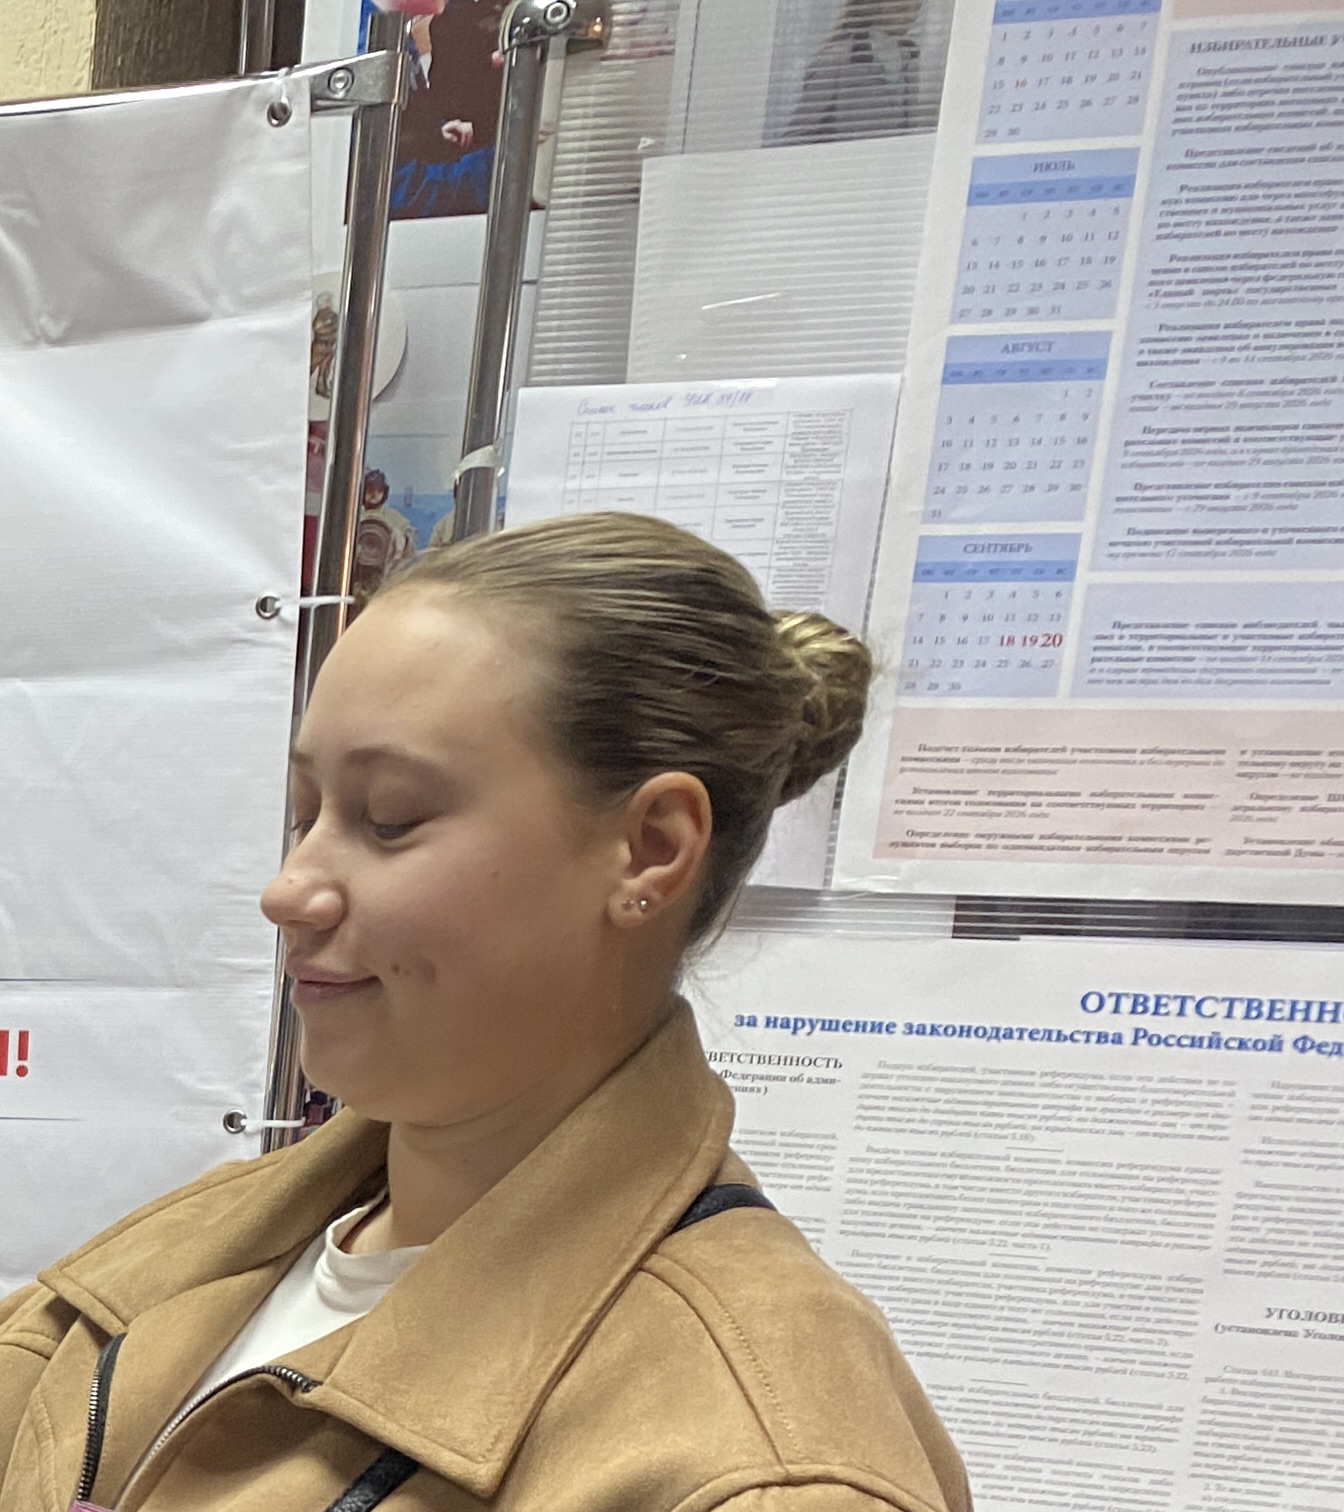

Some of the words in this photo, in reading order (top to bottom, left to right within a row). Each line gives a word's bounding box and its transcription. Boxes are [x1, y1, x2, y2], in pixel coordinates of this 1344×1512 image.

[1001, 341, 1054, 354] АВГУСТ
[963, 543, 1033, 554] СЕНТЯБРЬ
[1000, 635, 1015, 647] 18
[1022, 635, 1038, 647] 19
[1040, 632, 1063, 648] 20
[734, 1012, 758, 1029] за
[766, 1013, 897, 1037] нарушение
[902, 1021, 1124, 1047] законодательства
[1132, 1028, 1283, 1056] Российской
[707, 1052, 843, 1069] ВЕТСТВЕННОСТЬ
[789, 1073, 804, 1083] об
